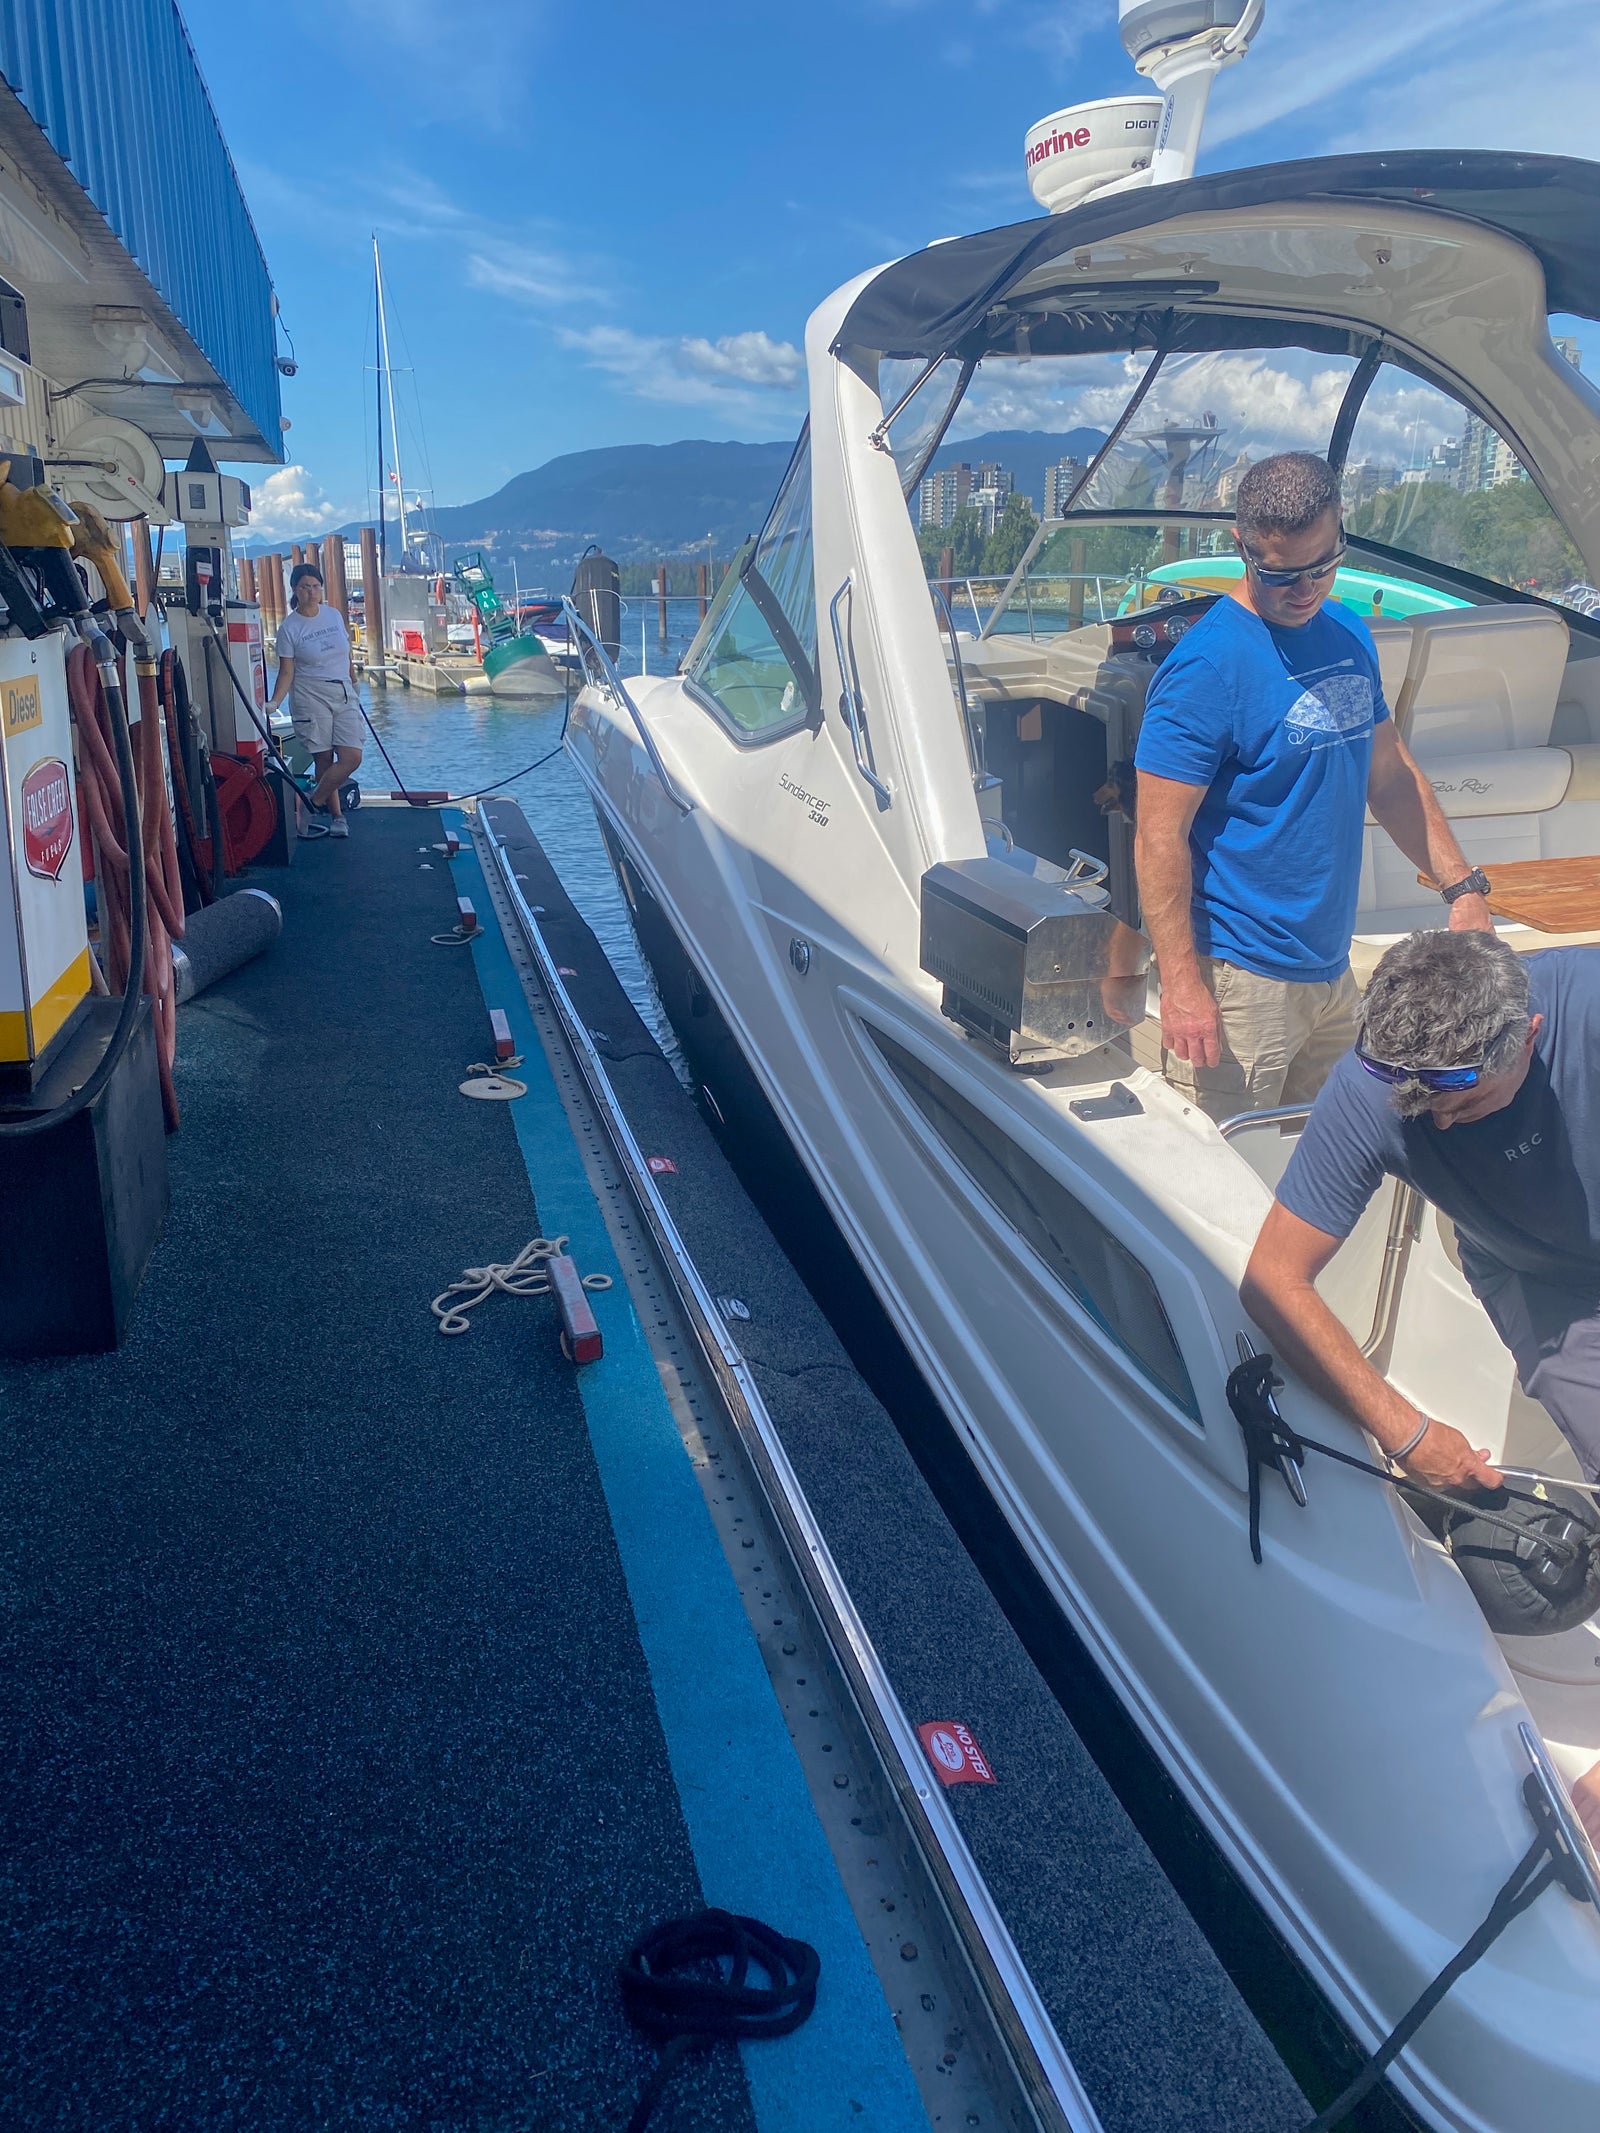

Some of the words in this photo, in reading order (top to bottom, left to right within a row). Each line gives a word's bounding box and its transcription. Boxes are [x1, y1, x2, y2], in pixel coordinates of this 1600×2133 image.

[1124, 120, 1160, 130] DIGIT
[1025, 127, 1091, 169] marine
[9, 684, 39, 726] Diesel
[778, 772, 831, 812] Sundancer
[1430, 781, 1457, 792] Sea
[1458, 778, 1494, 794] Ray
[27, 786, 48, 832] FALSE
[47, 778, 67, 818] CREEK
[808, 809, 829, 827] 330
[41, 839, 62, 865] FUELS
[1504, 1133, 1542, 1161] REC
[953, 1724, 973, 1745] NO
[964, 1745, 990, 1779] STEP
